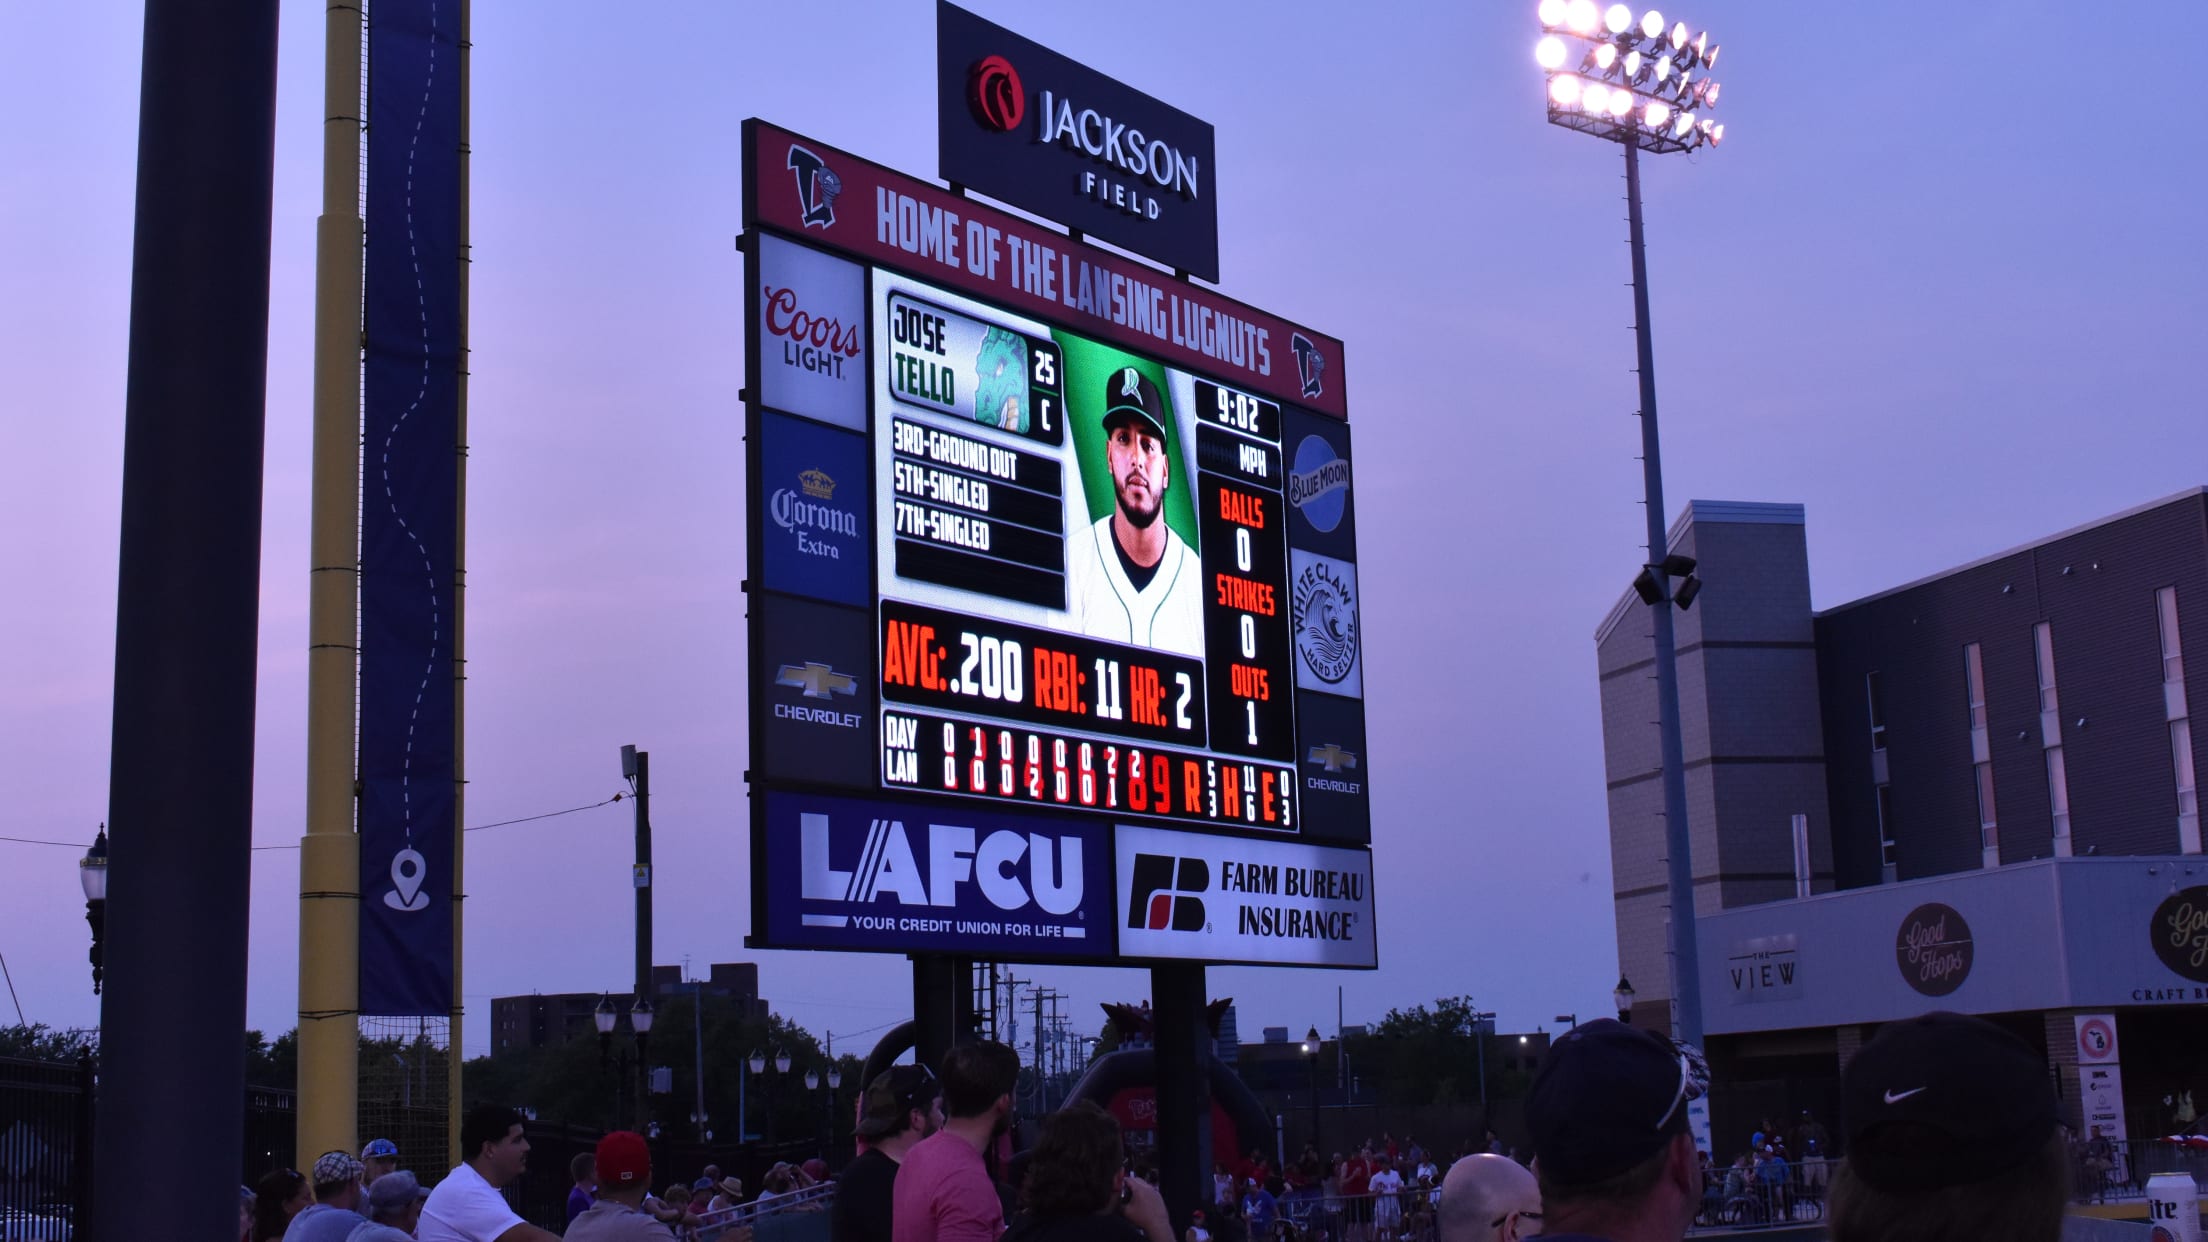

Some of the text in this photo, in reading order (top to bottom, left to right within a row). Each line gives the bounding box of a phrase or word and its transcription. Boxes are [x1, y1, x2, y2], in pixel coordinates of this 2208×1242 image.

[1040, 90, 1198, 200] JACKSON
[1083, 171, 1159, 220] FIELD
[877, 185, 1271, 377] HOME OF THE LANSING LUGNUTS
[763, 285, 861, 358] Coors
[894, 303, 946, 356] JOSE
[784, 340, 844, 380] LIGHT
[894, 351, 955, 407] TELLO
[1035, 349, 1055, 386] 25
[1041, 398, 1052, 432] C
[1217, 386, 1259, 434] 9:02
[894, 420, 1017, 481] 3RD-GROUND OUT
[1239, 443, 1267, 478] MPH
[894, 460, 989, 512] 5TH-SINGLED
[1290, 463, 1348, 506] BLUE MOON
[770, 487, 857, 538] Corona
[895, 501, 990, 552] 7TH-SINGLED
[1220, 487, 1264, 529] BALLS
[797, 530, 840, 560] Extra
[1236, 527, 1251, 573] 0
[1217, 572, 1275, 617] STRIKES
[1296, 562, 1351, 634] WHITE CLAW
[1240, 614, 1256, 660] 0
[1307, 622, 1354, 678] HARD SELTZER
[884, 619, 1192, 730] AVG: .200 RBI: 11 HR: 2
[1231, 663, 1269, 702] OUTS
[774, 703, 862, 729] CHEVROLET
[1246, 700, 1258, 746] 1
[886, 715, 1141, 778] DAY 0 1 0 0 0 0 2 2
[886, 748, 1117, 806] LAN 0 0 0 2 0 0 1
[1152, 754, 1171, 814] 9
[1184, 760, 1201, 814] R
[1207, 760, 1216, 788] 5
[1223, 765, 1240, 818] H
[1243, 765, 1256, 793] 11
[1262, 771, 1276, 822] E
[1280, 770, 1290, 797] 0
[1307, 776, 1361, 796] CHEVROLET
[1208, 789, 1217, 818] 3
[1246, 794, 1256, 822] 6
[1282, 799, 1291, 826] 3
[800, 811, 1084, 916] LAFCU
[1221, 860, 1364, 902] FARM BUREAU
[853, 915, 1062, 938] YOUR CREDIT UNION FOR LIFE
[1238, 904, 1353, 941] INSURANCE
[1905, 914, 1945, 964] Good
[1730, 962, 1795, 991] VIEW
[1752, 951, 1771, 961] THE
[1920, 948, 1964, 981] Hops
[2132, 988, 2185, 1001] CRAFT
